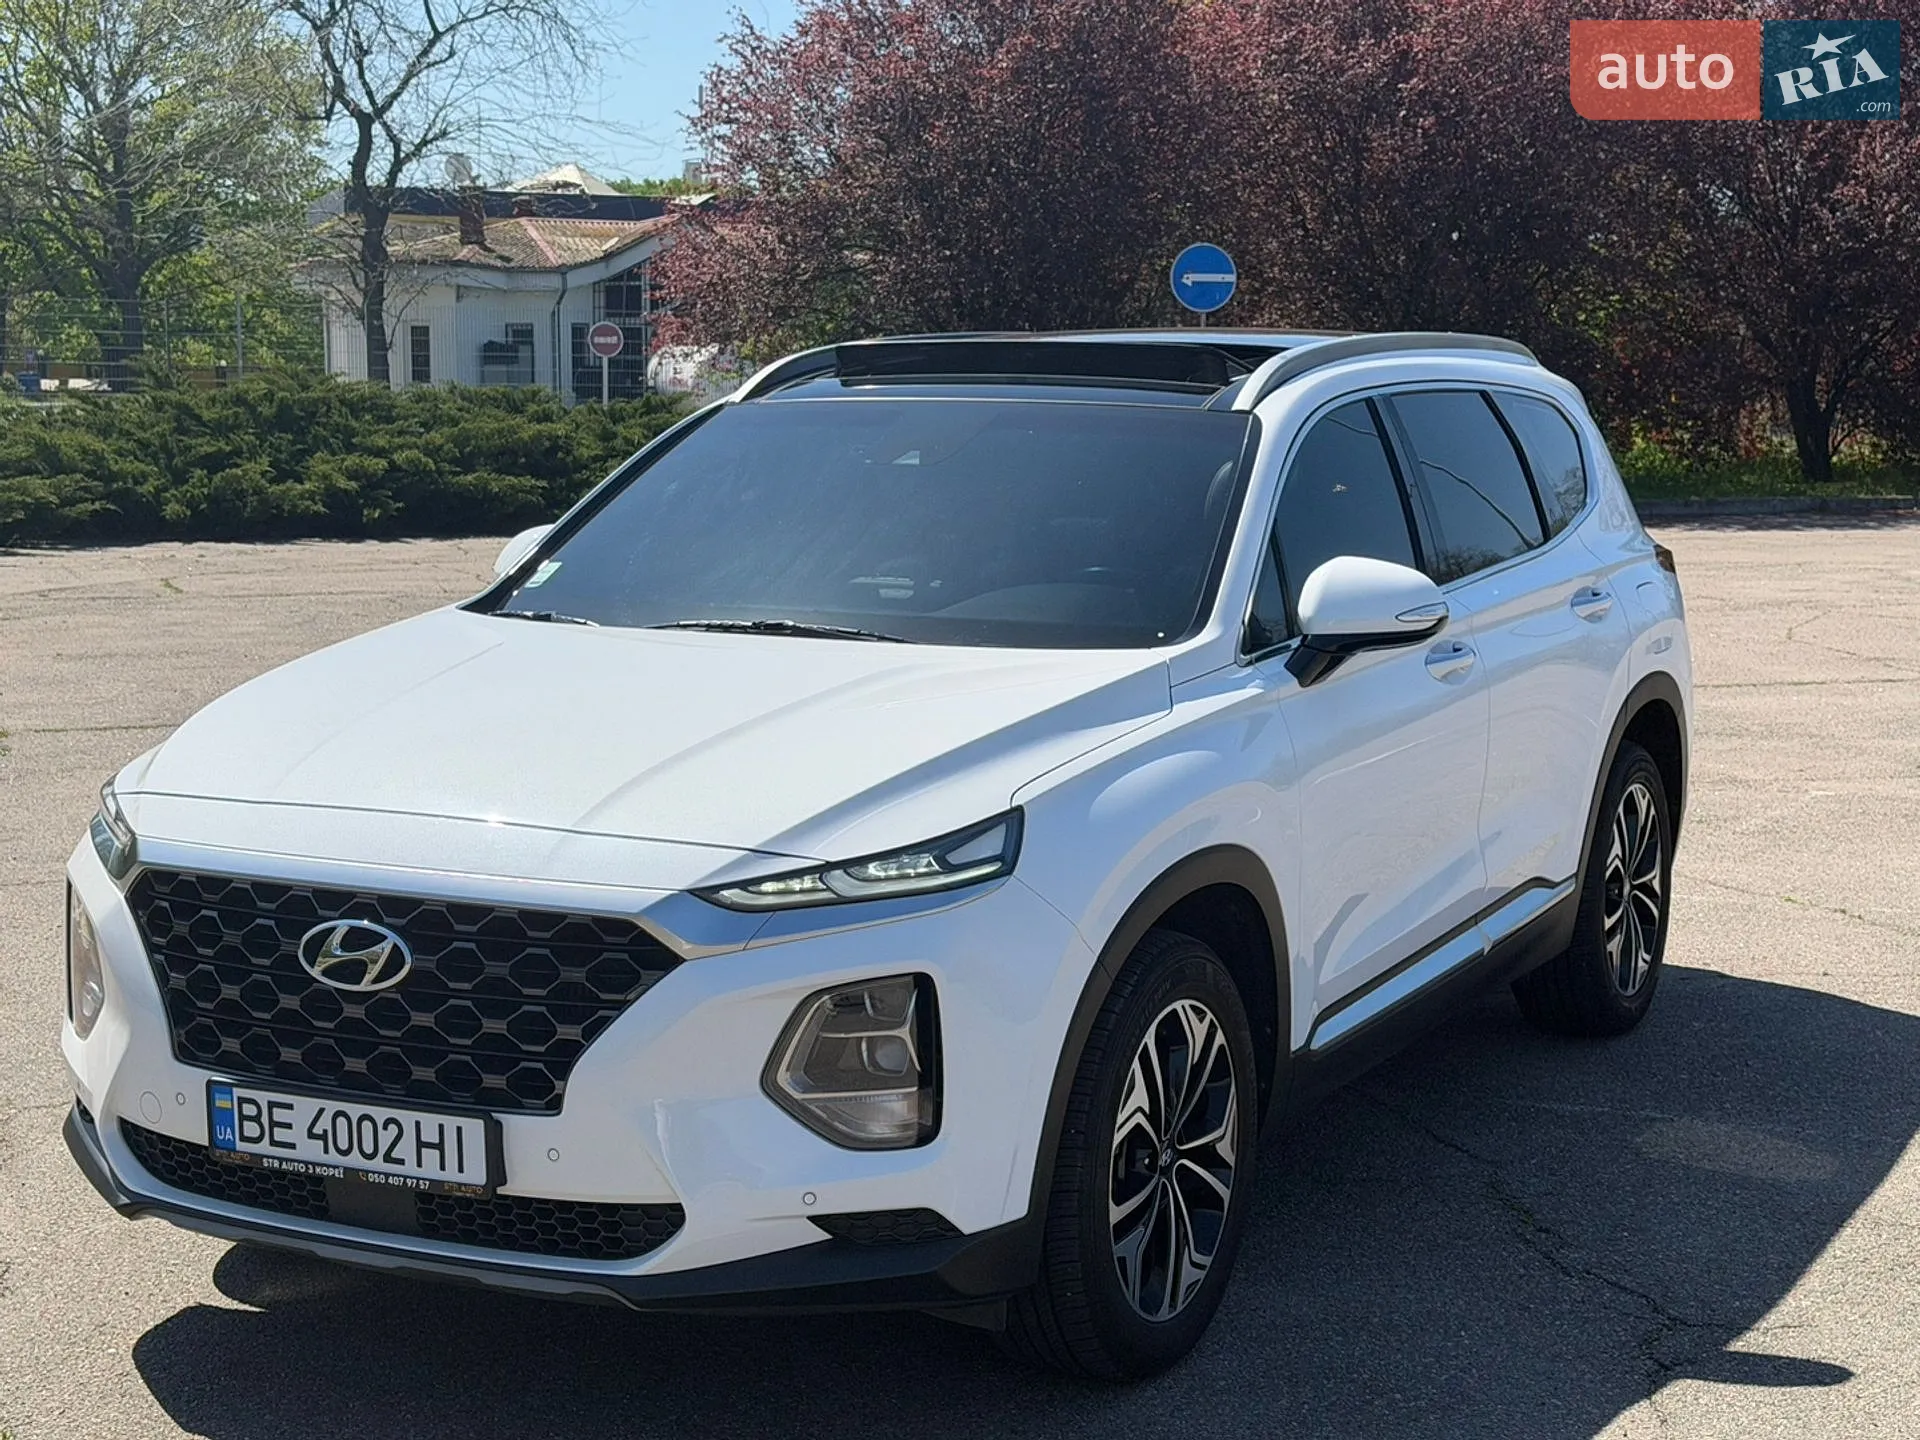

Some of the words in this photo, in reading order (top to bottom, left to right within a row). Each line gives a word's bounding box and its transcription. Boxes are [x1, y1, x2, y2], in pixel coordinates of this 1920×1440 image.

[216, 1125, 234, 1141] UA
[237, 1095, 297, 1151] BE
[306, 1107, 405, 1166] 4002
[414, 1119, 464, 1174] HI
[262, 1158, 280, 1169] STR
[281, 1161, 306, 1173] AUTO
[368, 1173, 386, 1184] 050
[387, 1176, 404, 1187] 407
[406, 1179, 417, 1189] 97
[419, 1180, 431, 1191] 57
